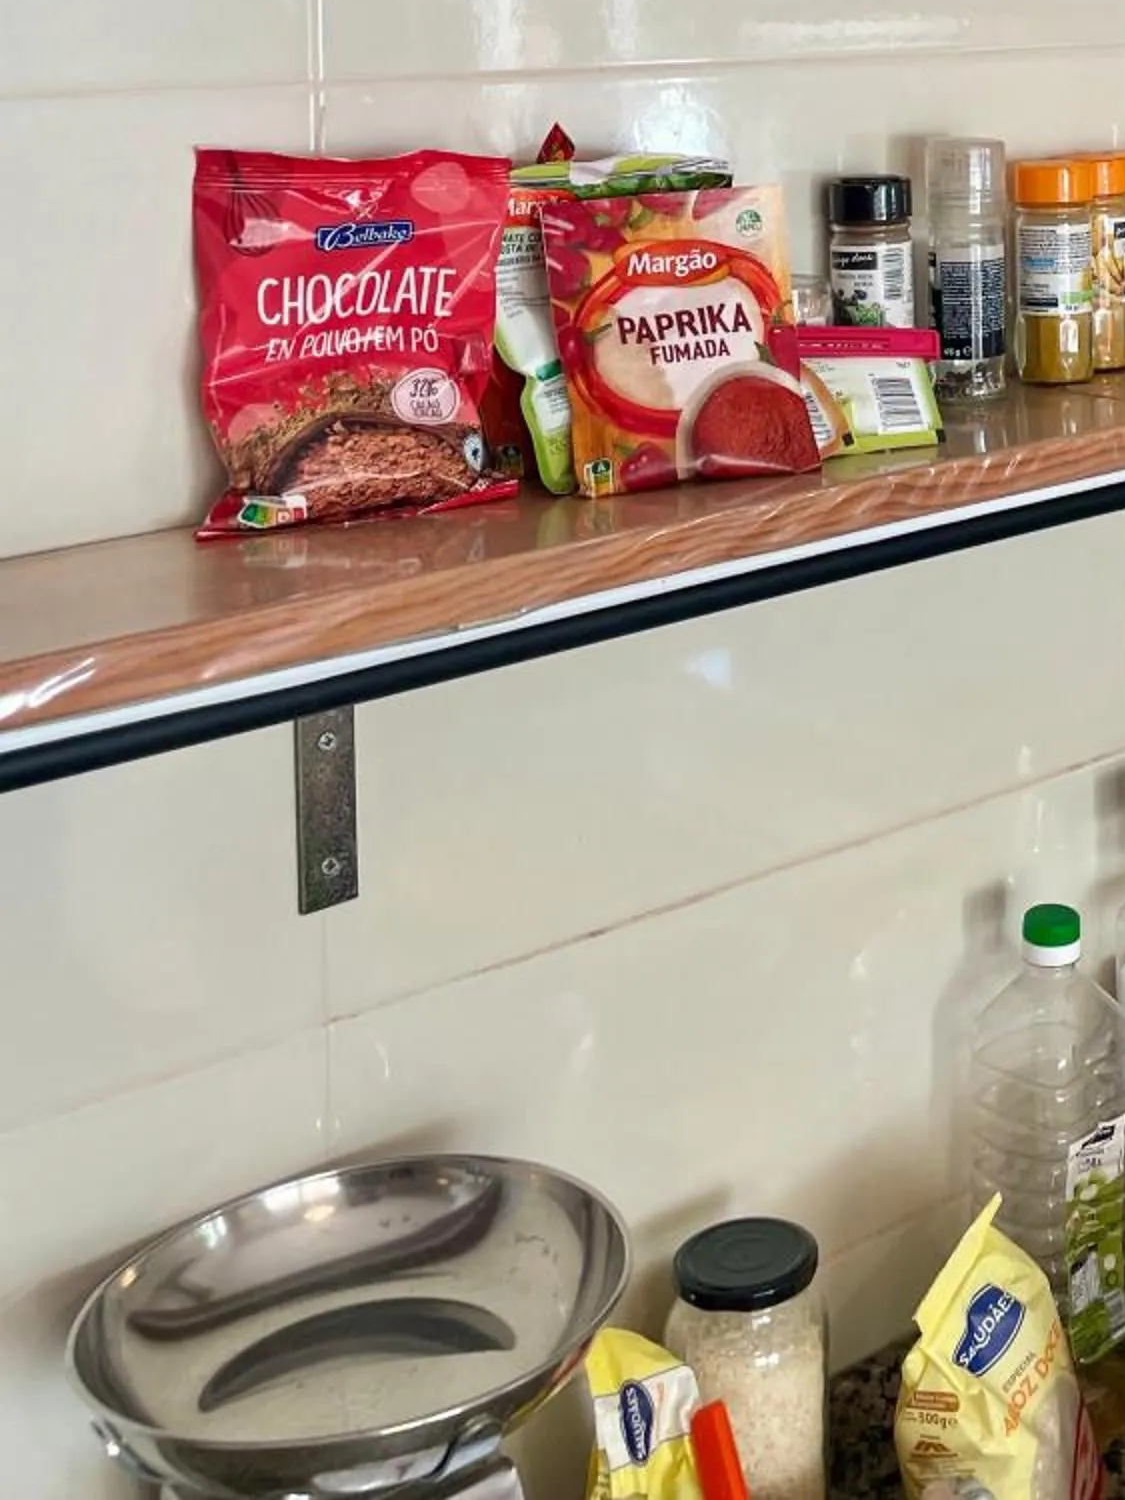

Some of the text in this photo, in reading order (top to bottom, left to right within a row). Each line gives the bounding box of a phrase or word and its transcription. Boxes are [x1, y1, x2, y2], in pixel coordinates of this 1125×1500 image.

[627, 248, 718, 278] Margão
[257, 265, 457, 326] CHOCOLATE
[265, 337, 297, 363] EN
[411, 321, 440, 353] PÓ
[616, 301, 753, 345] PAPRIKA
[650, 338, 732, 366] FUMADA
